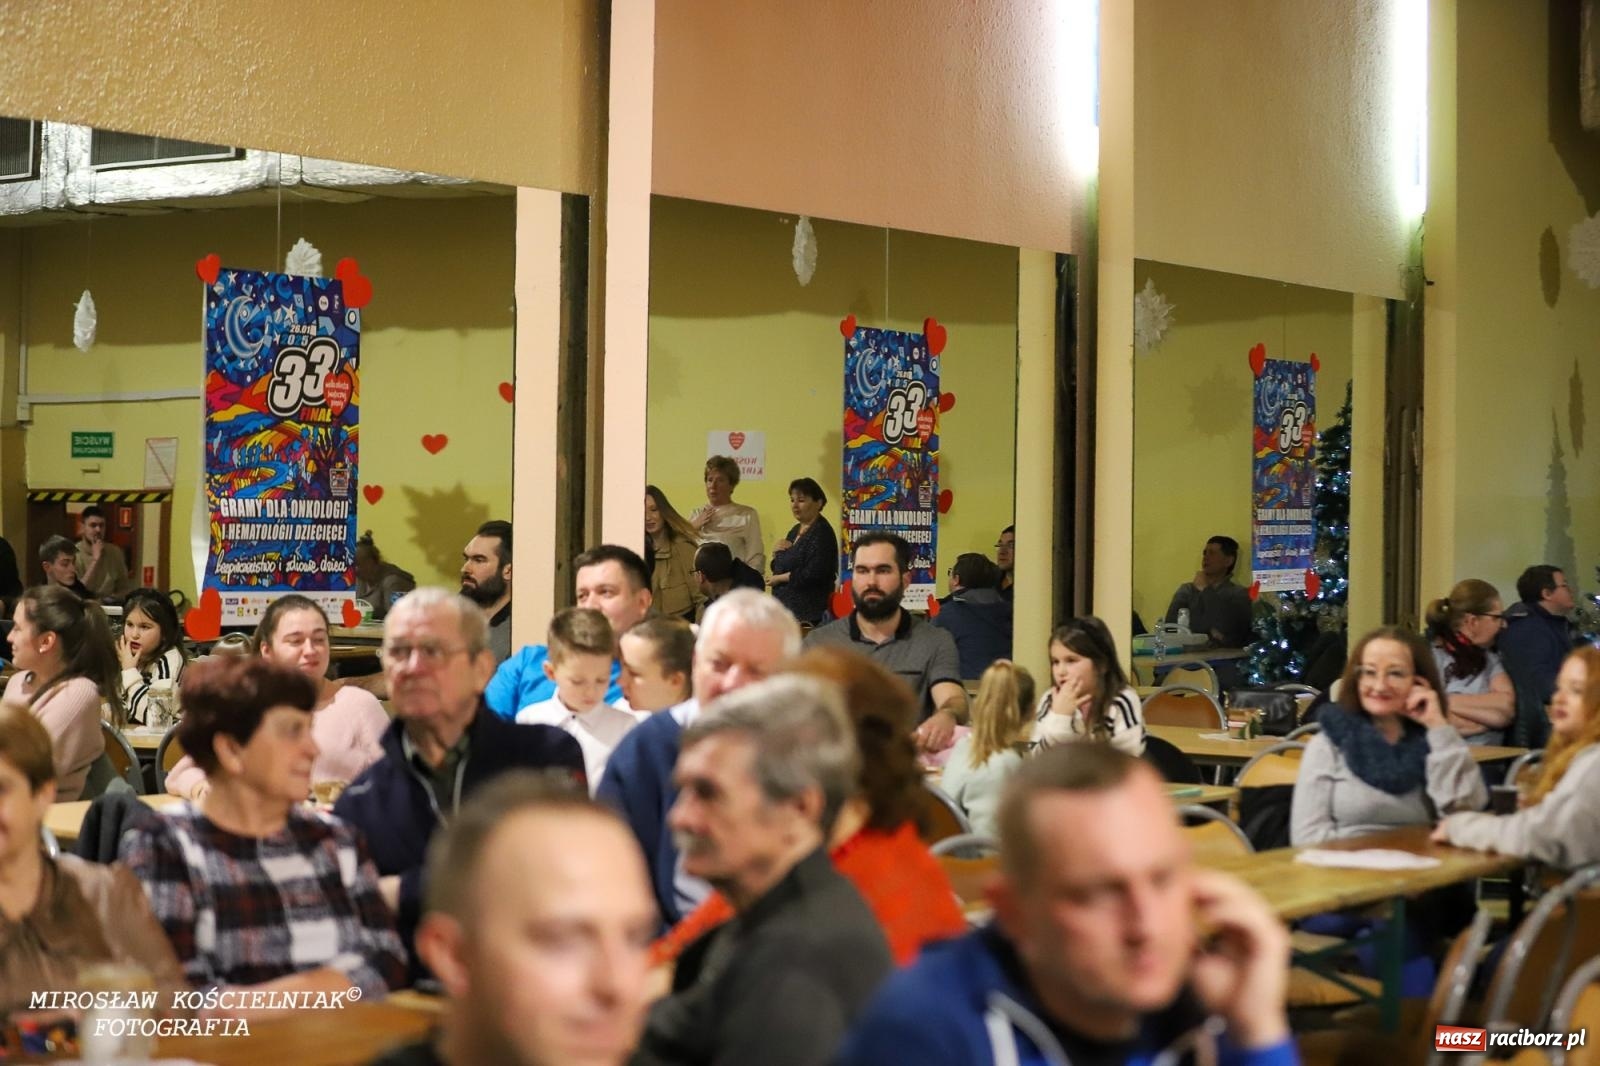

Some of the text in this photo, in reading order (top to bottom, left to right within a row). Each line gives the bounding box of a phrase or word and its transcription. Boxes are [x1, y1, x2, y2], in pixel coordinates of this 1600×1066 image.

[270, 340, 338, 413] 33
[885, 383, 925, 442] 33
[1281, 403, 1306, 452] 33
[220, 498, 349, 519] GRAMY DLA ONKOLOGII
[849, 509, 932, 526] GRAMY DLA ONKOLOGII
[228, 523, 293, 541] HEMATOLOGII
[294, 523, 347, 543] DZIECIĘCEJ
